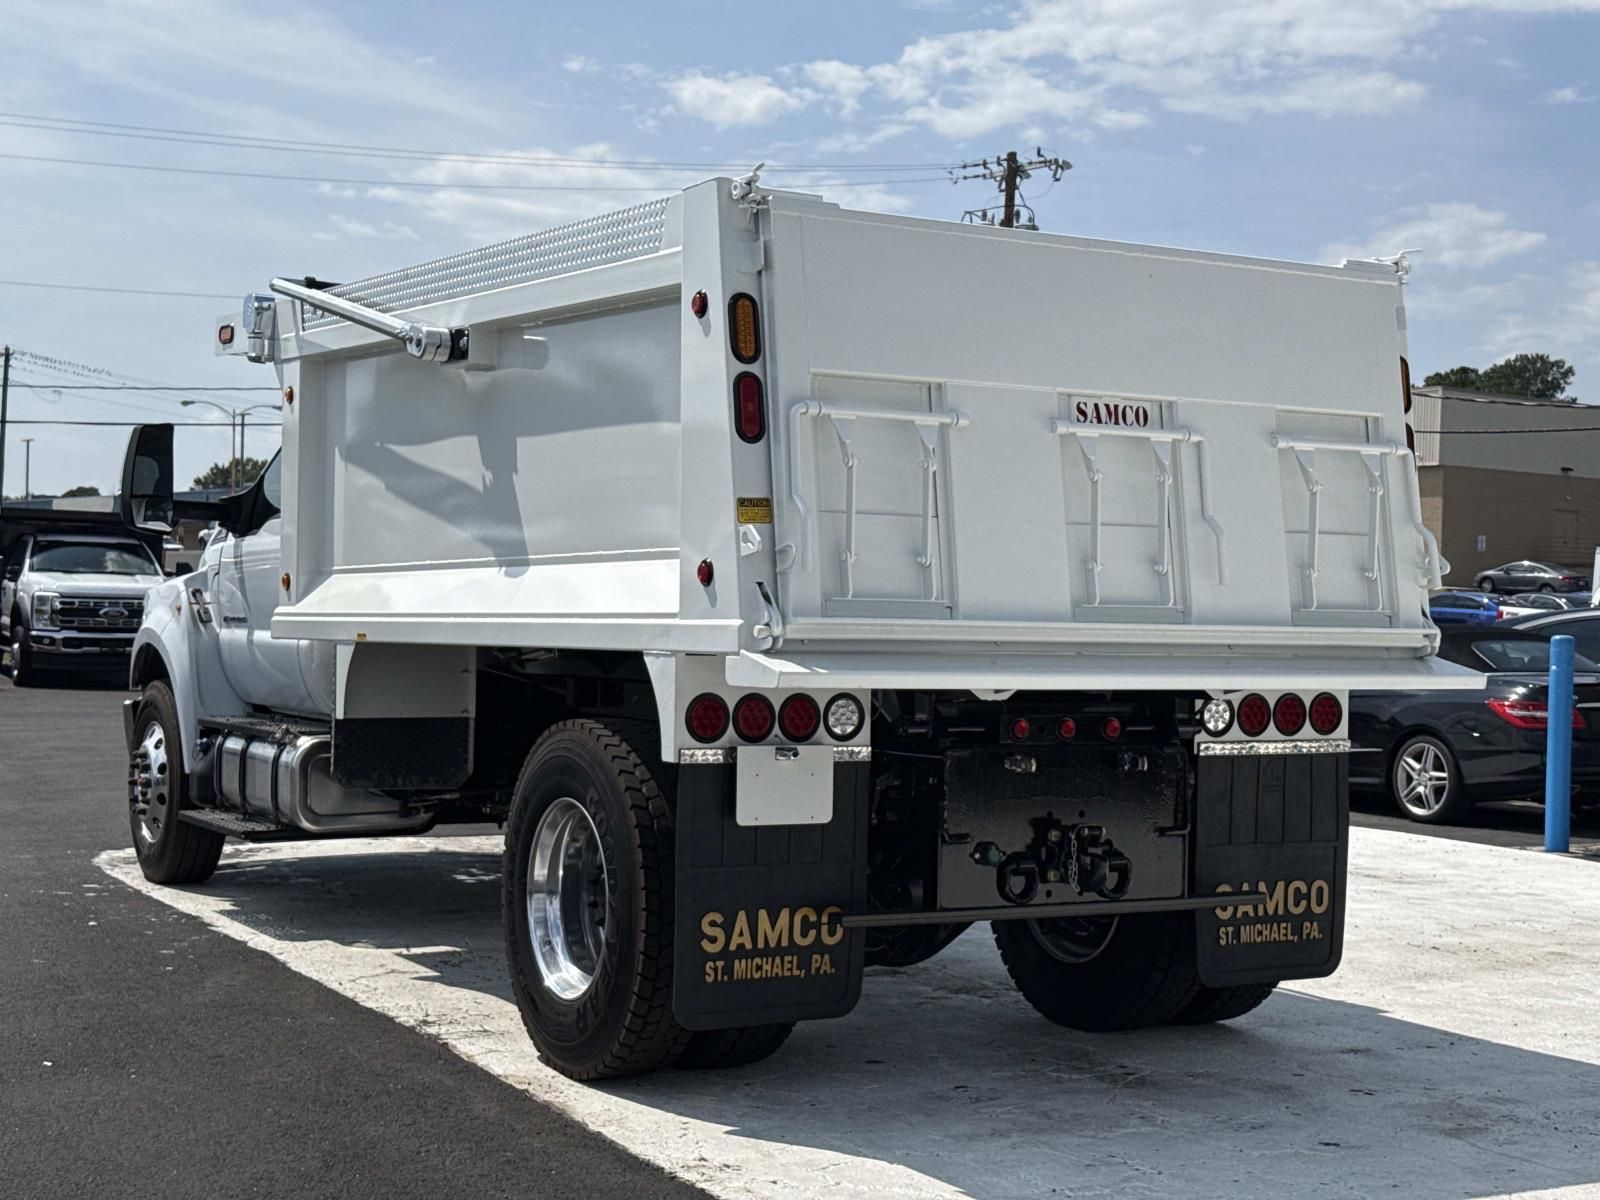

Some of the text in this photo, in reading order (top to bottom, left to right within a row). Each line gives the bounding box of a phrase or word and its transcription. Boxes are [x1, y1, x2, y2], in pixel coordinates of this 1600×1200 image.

[1076, 401, 1149, 427] SAMCO
[701, 906, 844, 953] SAMCO
[1219, 921, 1323, 946] ST. MICHAEL, PA.
[705, 953, 836, 983] ST. MICHAEL, PA.
